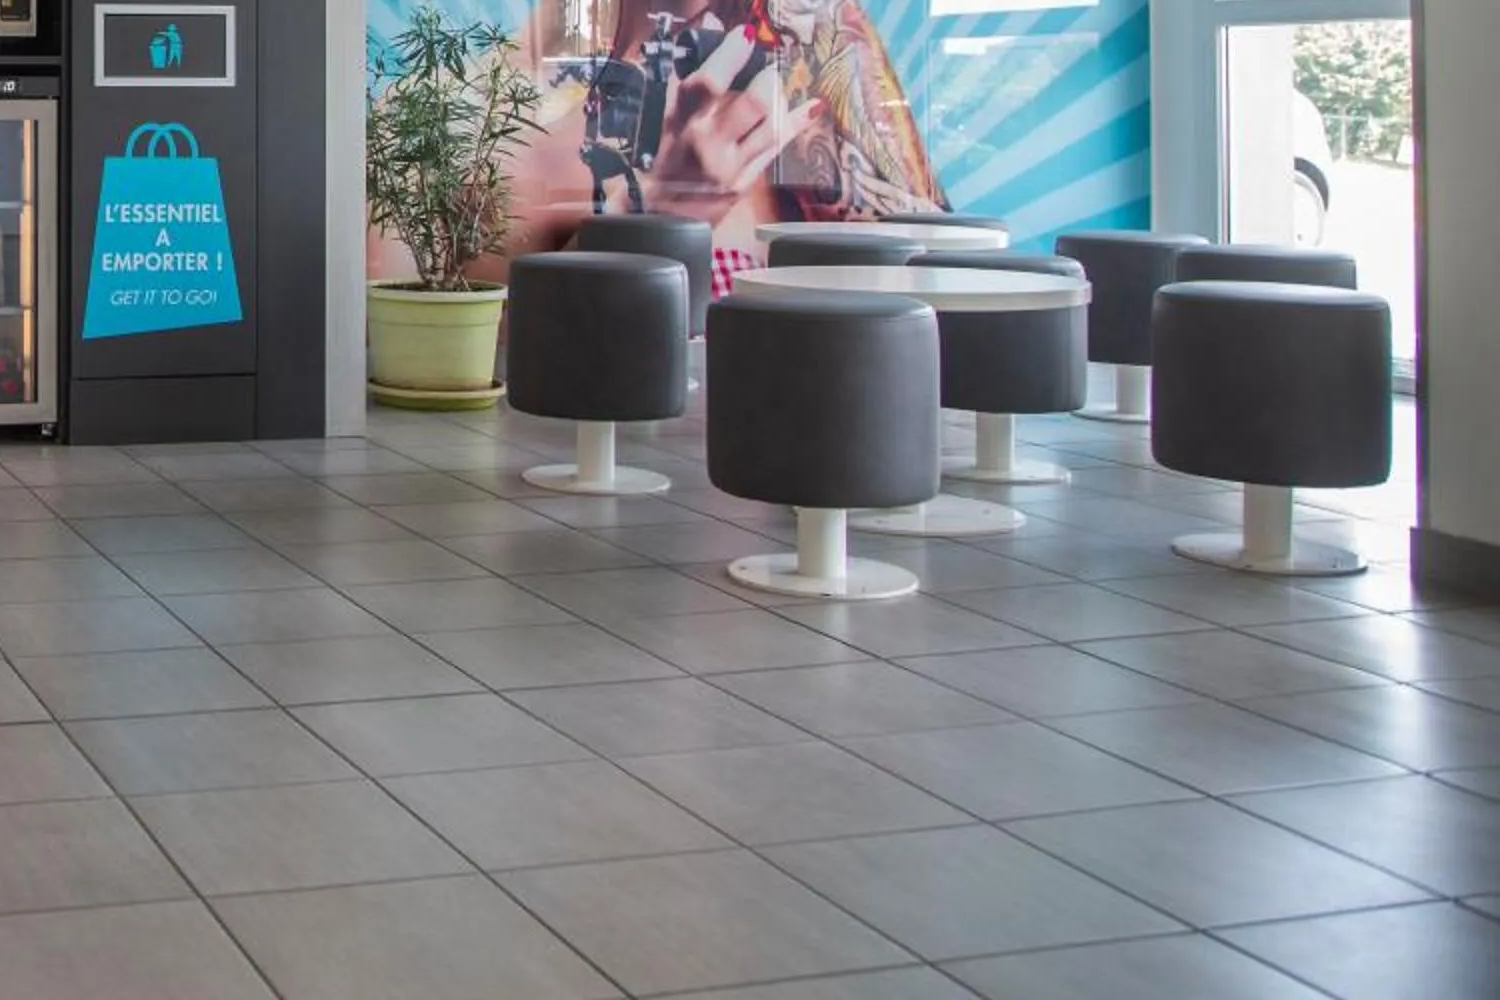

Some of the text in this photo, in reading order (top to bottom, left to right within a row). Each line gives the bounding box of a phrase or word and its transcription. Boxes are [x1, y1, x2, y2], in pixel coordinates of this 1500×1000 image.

[104, 203, 222, 223] L'ESSENTIEL
[155, 227, 171, 248] A
[102, 251, 209, 272] EMPORTER
[111, 289, 218, 305] GET IT TO GO!
